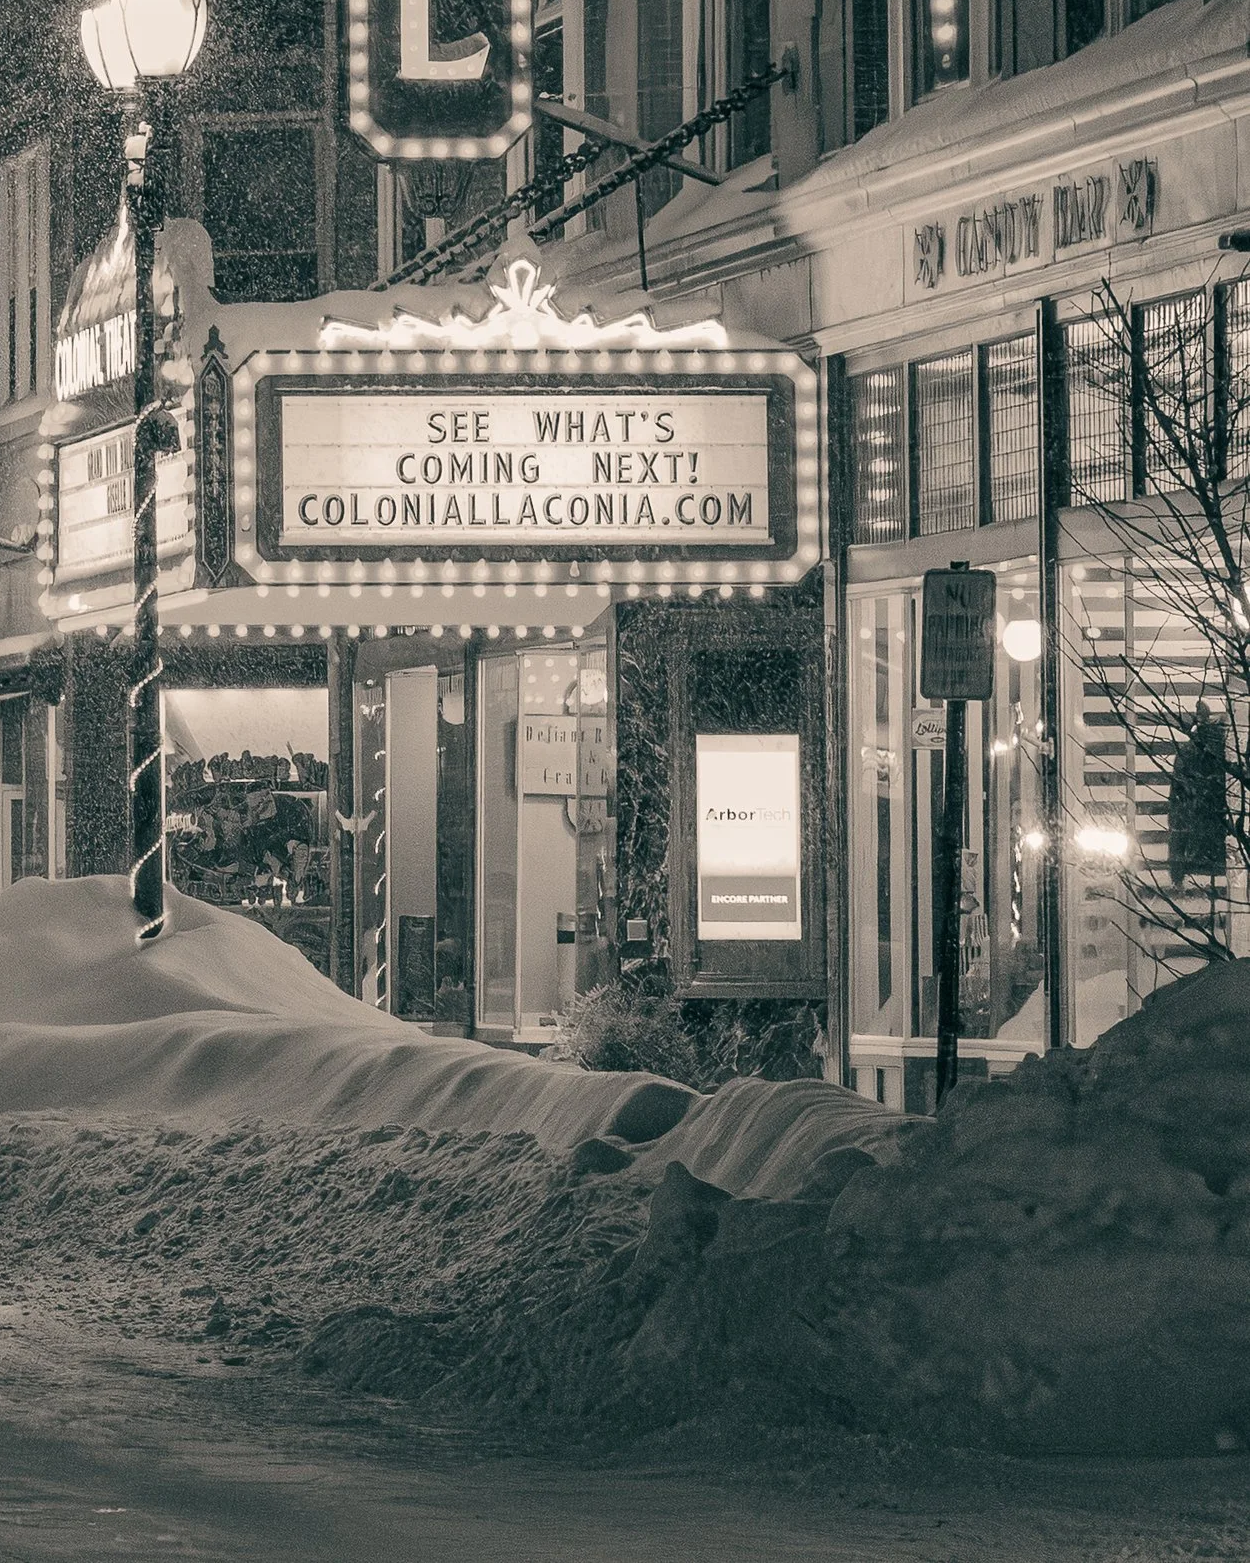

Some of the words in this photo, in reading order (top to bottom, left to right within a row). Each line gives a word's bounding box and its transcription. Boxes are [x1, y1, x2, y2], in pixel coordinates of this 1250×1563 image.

[55, 323, 104, 402] COLONIAL
[104, 309, 138, 381] THEAT
[426, 410, 491, 444] SEE
[532, 410, 676, 444] WHAT'S
[395, 451, 541, 485] COMING
[591, 451, 701, 485] NEXT!
[297, 492, 753, 526] COLONIALLACONIA.COM
[915, 722, 946, 736] Lollip
[711, 894, 748, 905] ENCORE
[748, 894, 789, 905] PARTNER
